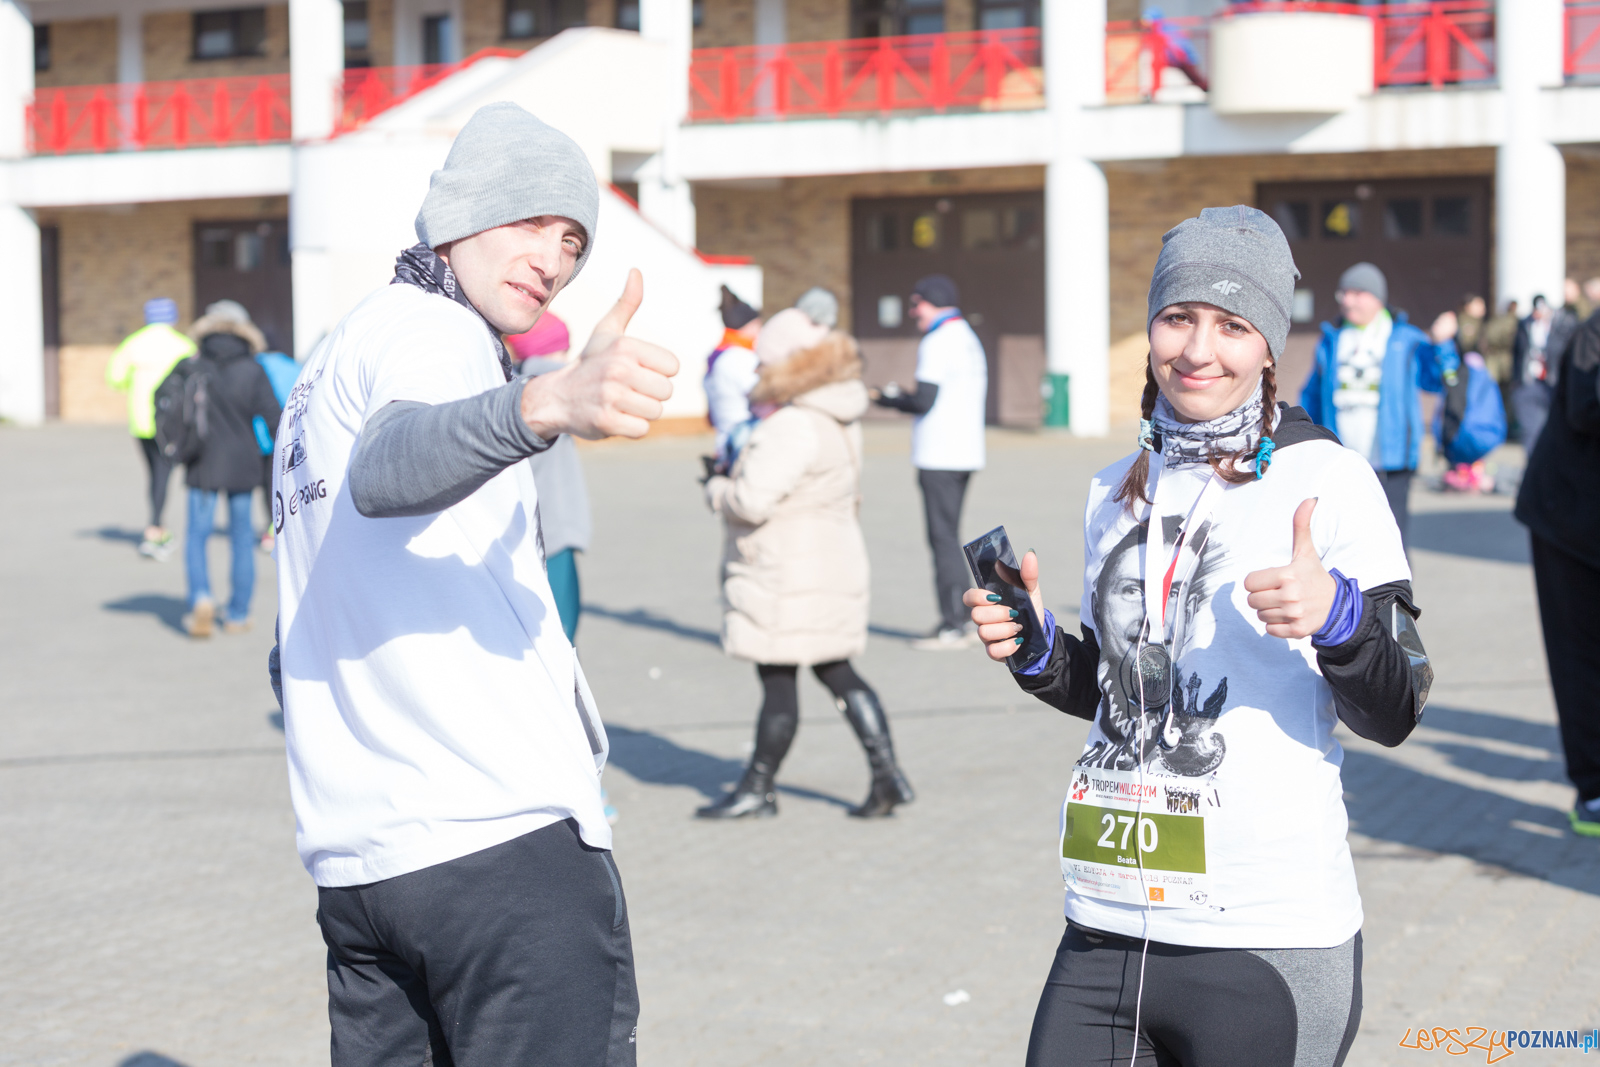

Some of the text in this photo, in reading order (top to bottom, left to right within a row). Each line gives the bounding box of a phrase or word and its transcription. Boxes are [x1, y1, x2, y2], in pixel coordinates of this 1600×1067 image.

[1325, 204, 1349, 236] 4
[1211, 279, 1243, 296] 4F
[1097, 813, 1159, 853] 270
[1117, 855, 1137, 865] Beata
